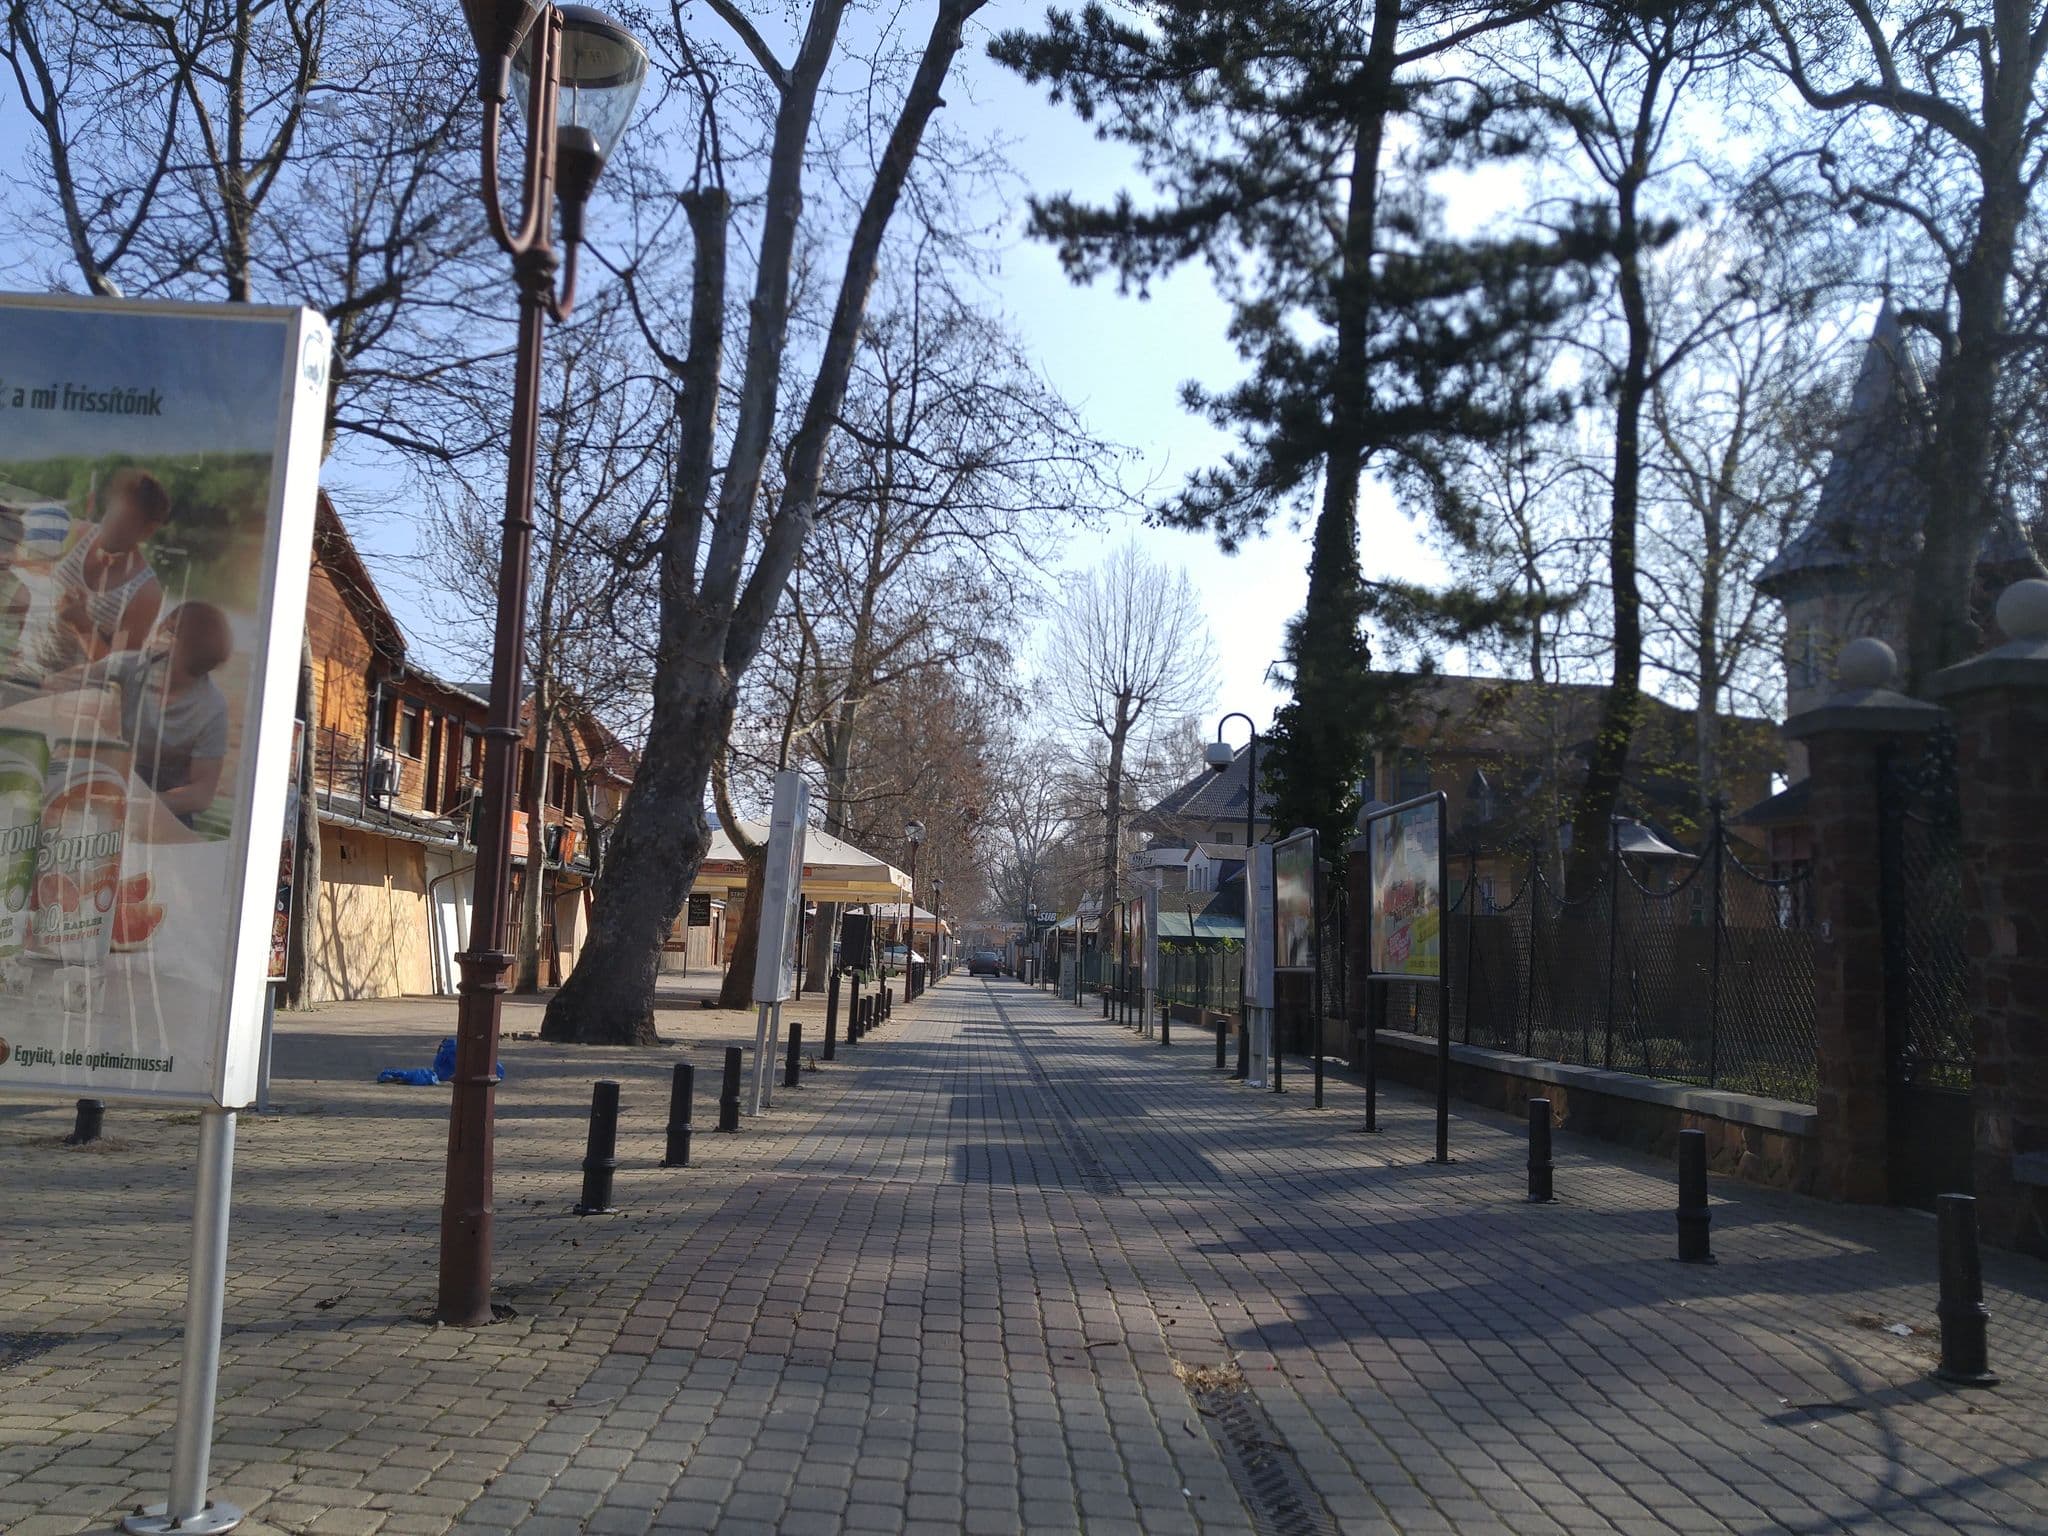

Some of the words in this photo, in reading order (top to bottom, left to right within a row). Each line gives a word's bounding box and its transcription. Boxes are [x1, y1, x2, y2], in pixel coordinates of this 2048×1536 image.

[12, 387, 25, 409] a
[31, 383, 58, 411] mi
[15, 1044, 56, 1068] Együtt,
[59, 1048, 83, 1067] tele
[85, 1050, 175, 1073] optimizmussal
